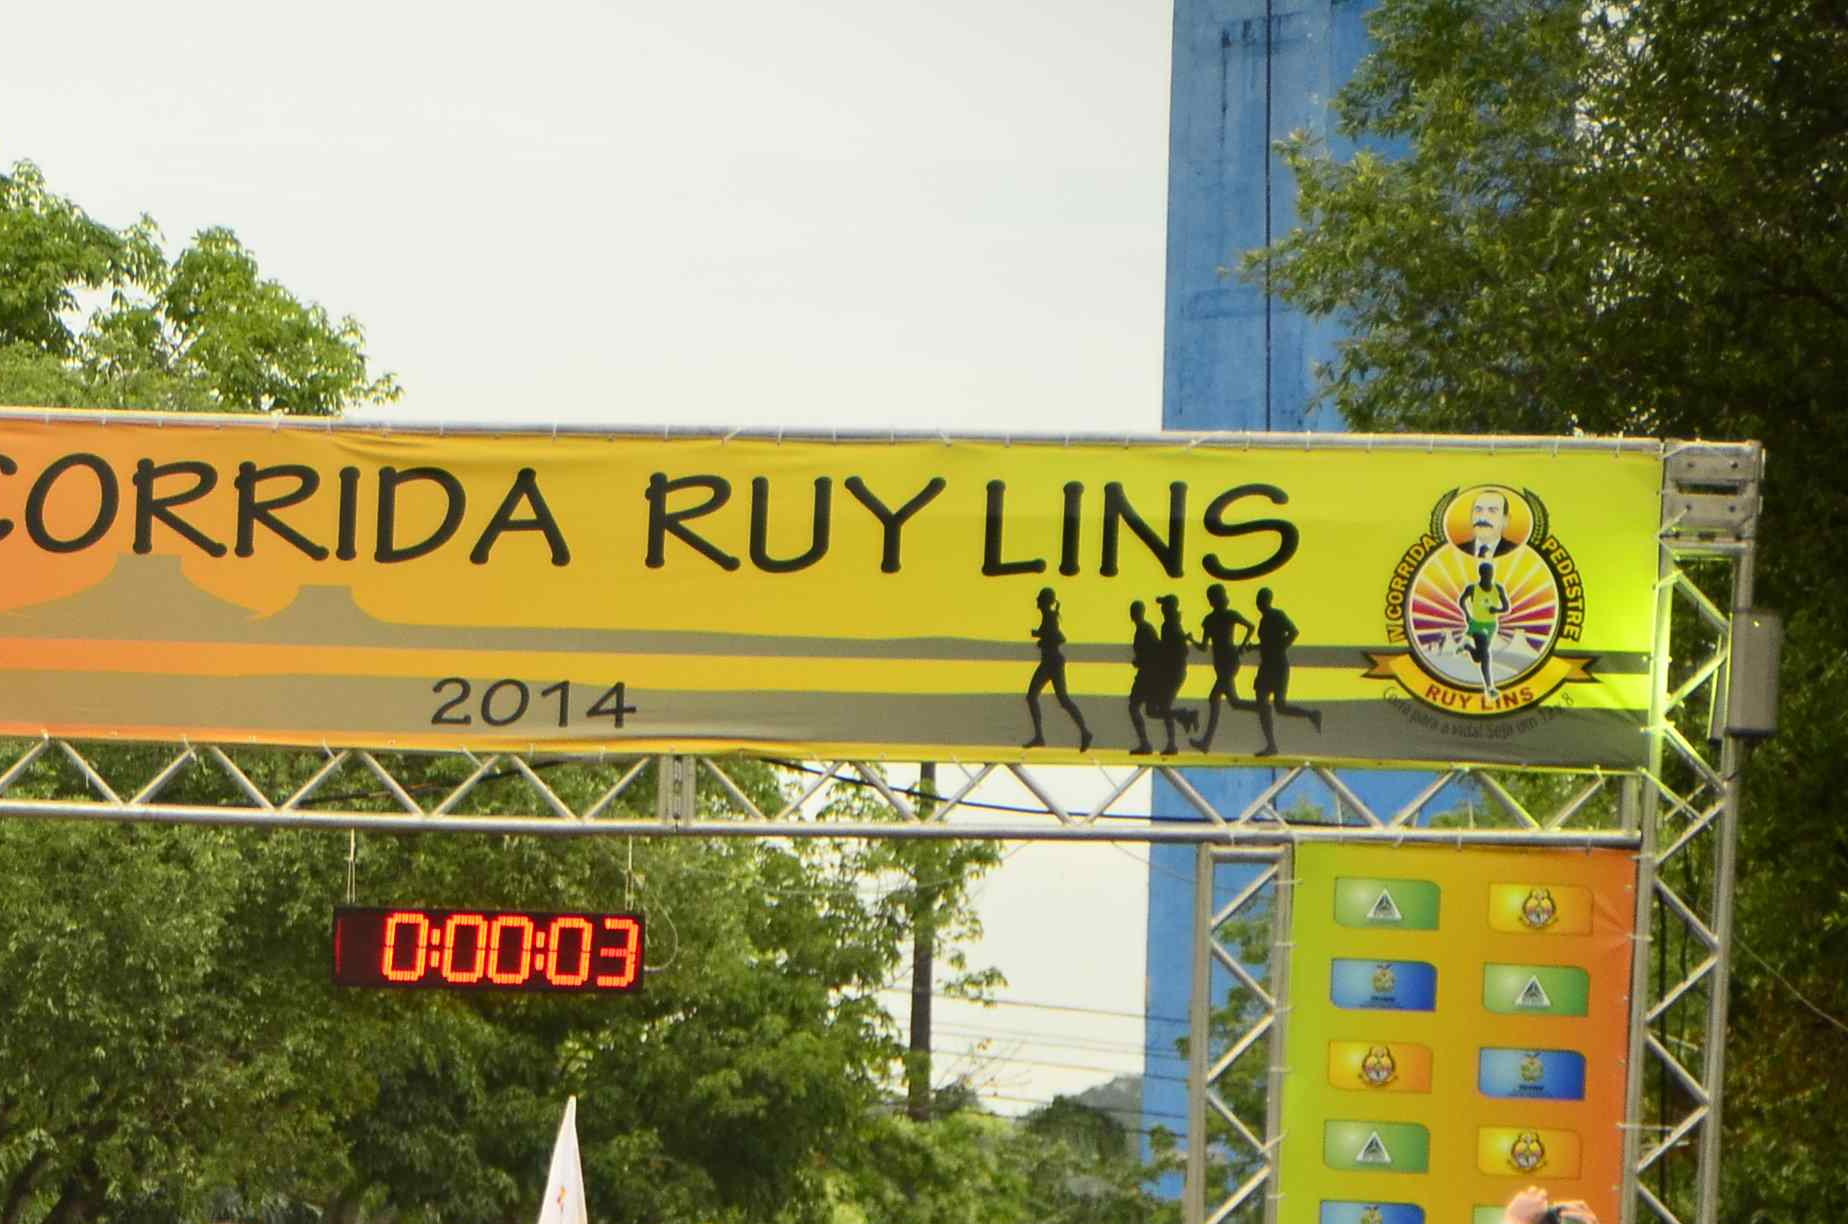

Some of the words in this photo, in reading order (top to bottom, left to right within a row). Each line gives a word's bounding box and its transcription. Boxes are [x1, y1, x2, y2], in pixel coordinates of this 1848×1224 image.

[645, 473, 945, 575] RUY
[981, 480, 1299, 581] LINS
[1385, 533, 1437, 620] CORRIDA
[1543, 537, 1583, 641] PEDESTRE
[430, 677, 637, 726] 2014
[1425, 685, 1473, 710] RUY
[1480, 687, 1534, 712] LINS
[382, 911, 640, 988] 0:00:03
